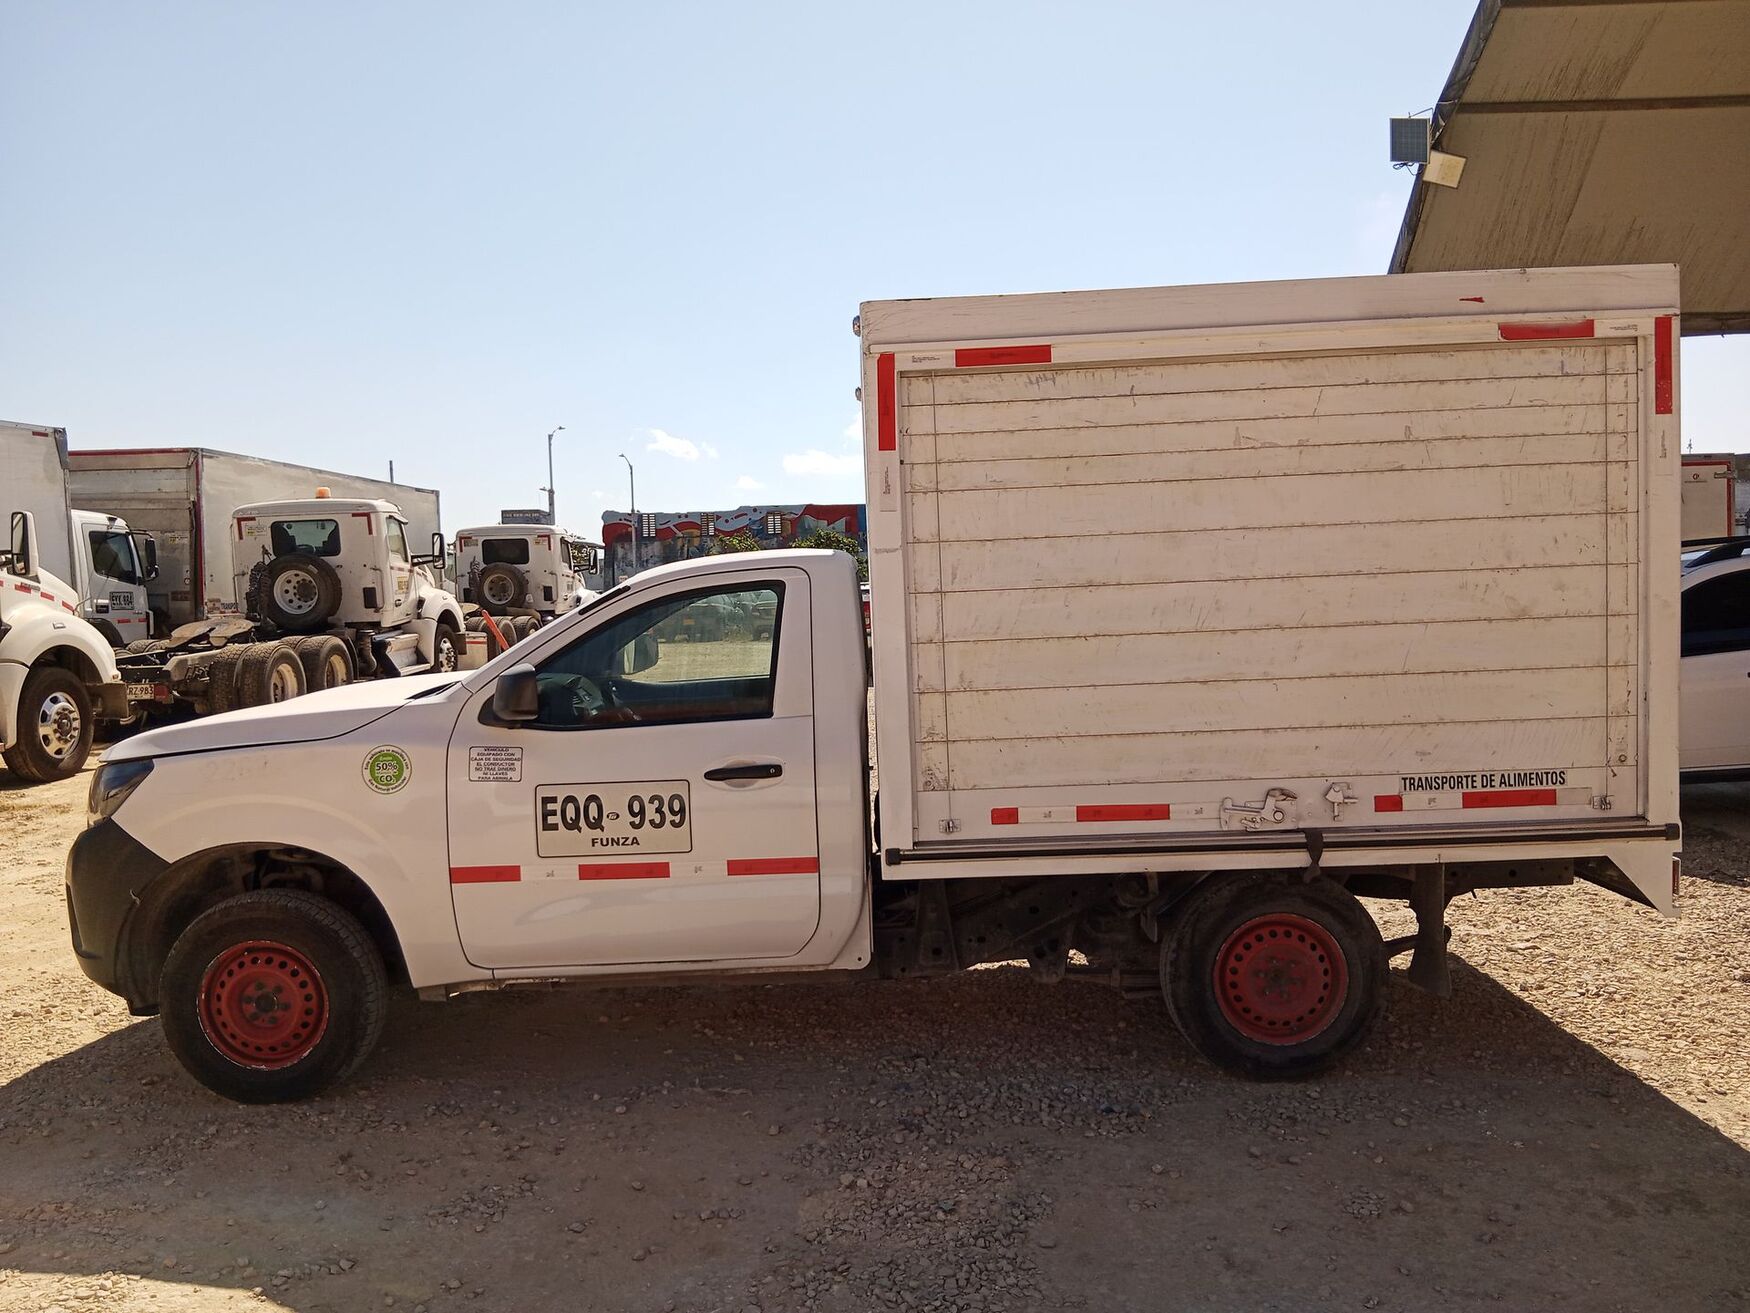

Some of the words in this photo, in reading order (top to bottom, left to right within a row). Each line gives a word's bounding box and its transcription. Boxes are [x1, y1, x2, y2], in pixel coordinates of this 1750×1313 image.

[376, 762, 398, 771] 50%
[1401, 774, 1477, 791] TRANSPORTE
[1481, 773, 1496, 788] DE
[1499, 770, 1566, 787] ALIMENTOS
[591, 836, 640, 847] FUNZA
